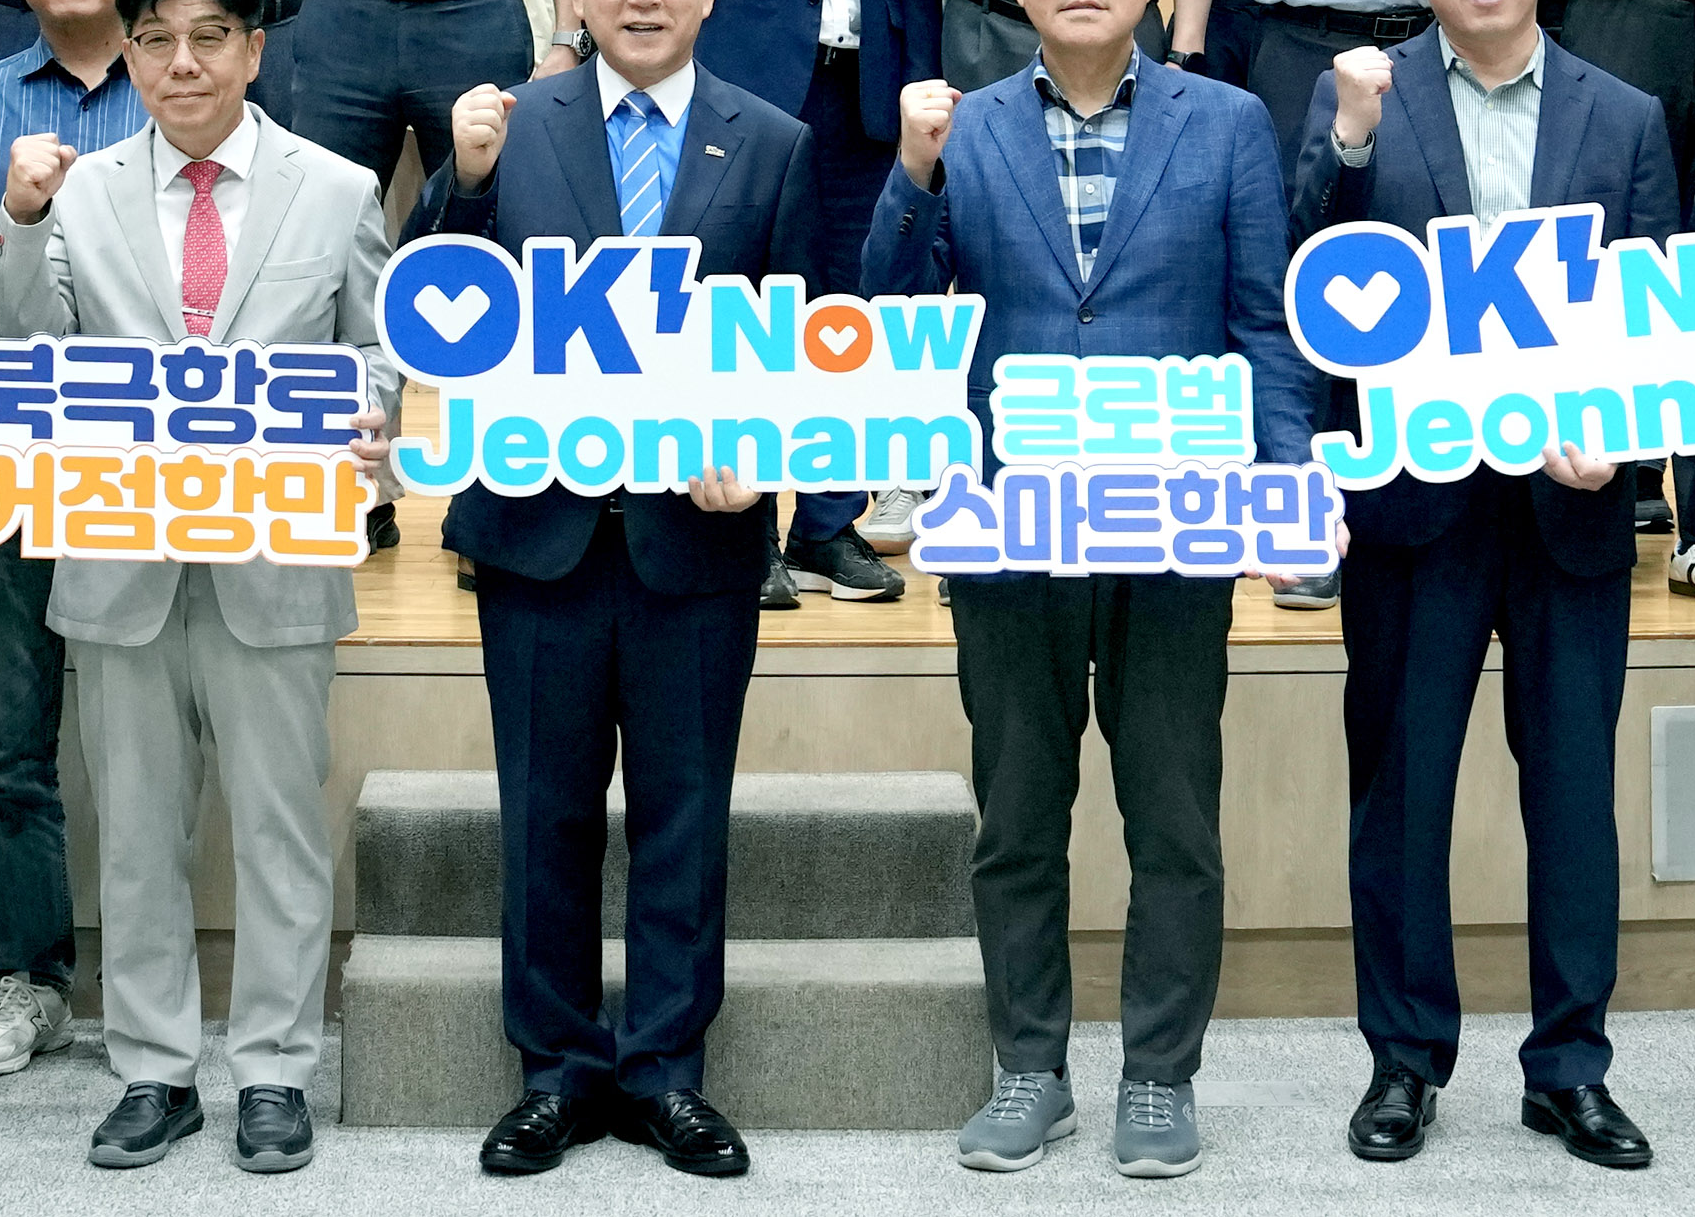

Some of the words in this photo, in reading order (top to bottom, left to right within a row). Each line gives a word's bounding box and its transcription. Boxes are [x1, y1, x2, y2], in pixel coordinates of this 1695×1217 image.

[711, 285, 975, 372] Now
[398, 398, 972, 486] Jeonnam
[1001, 364, 1246, 456] 글로벌
[920, 469, 1334, 565] 스마트항만
